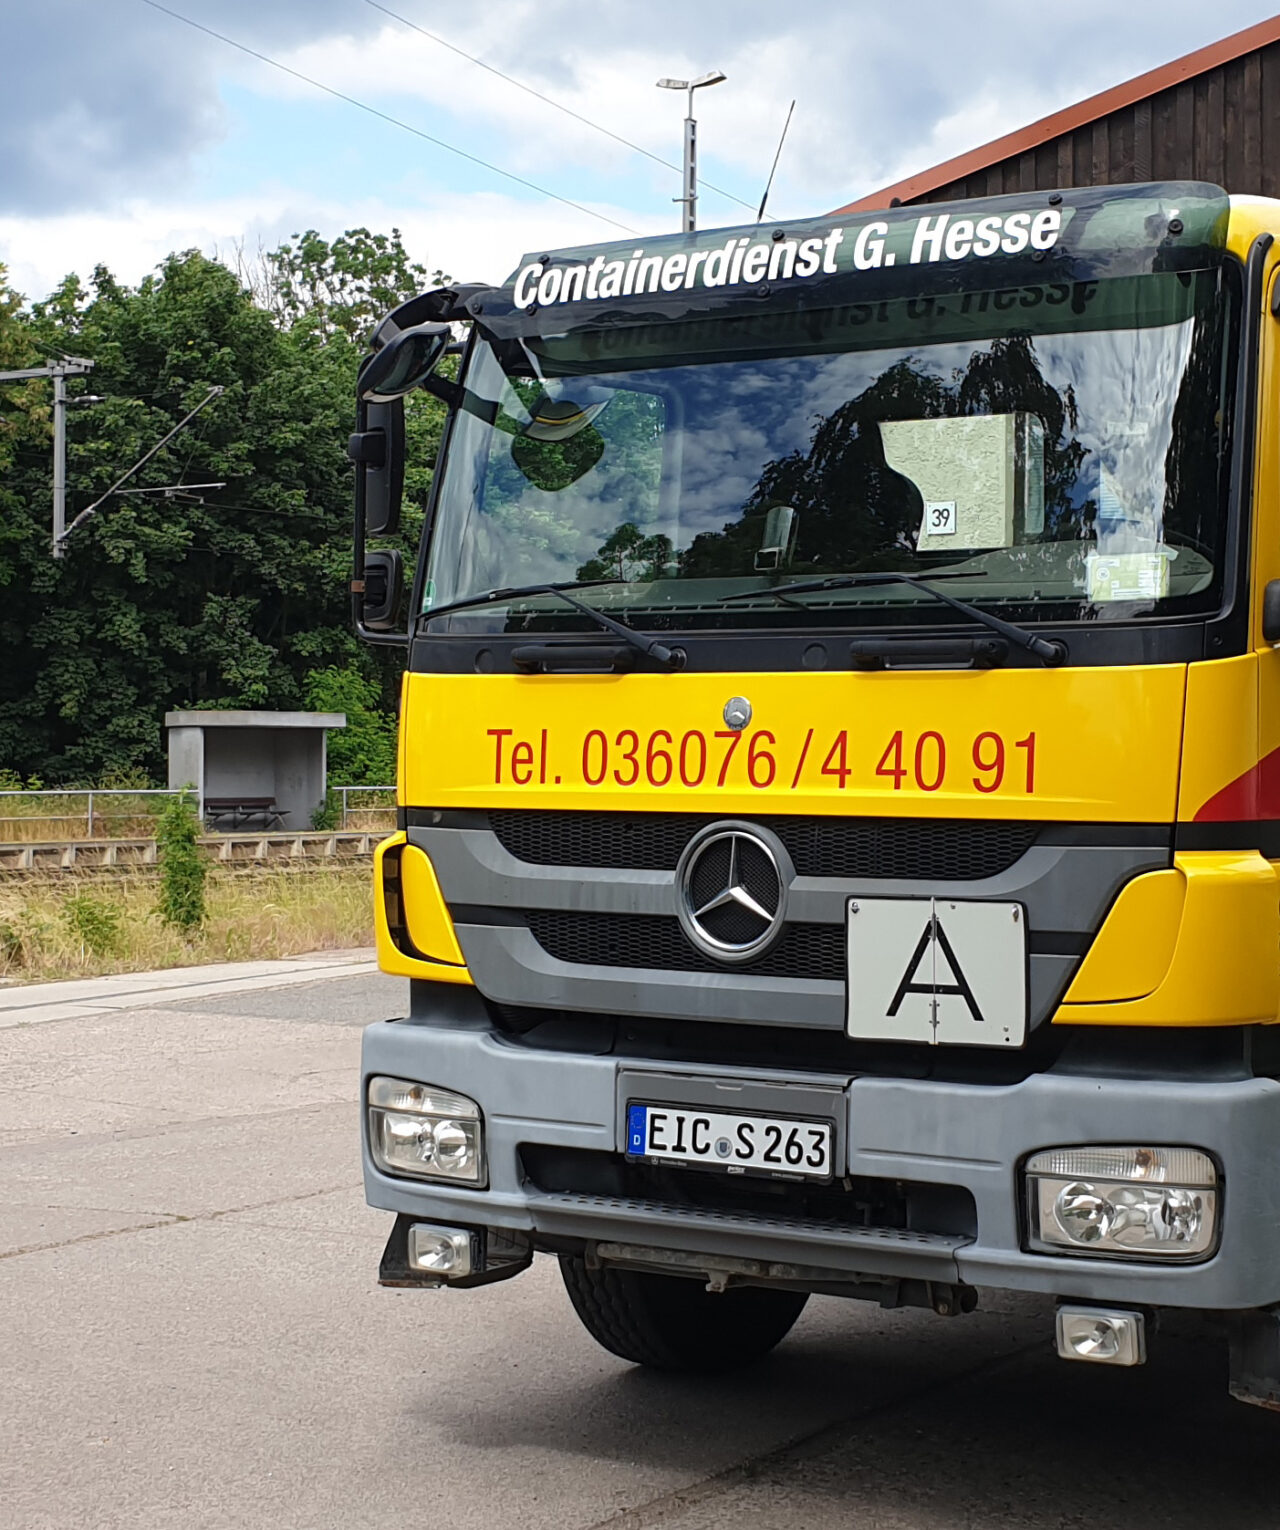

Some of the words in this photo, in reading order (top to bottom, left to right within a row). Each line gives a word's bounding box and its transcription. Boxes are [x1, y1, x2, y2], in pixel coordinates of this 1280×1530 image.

[513, 226, 844, 310] Containerdienst
[853, 221, 896, 273] G.
[909, 208, 1062, 264] Hesse
[931, 508, 951, 528] 39
[487, 728, 562, 785] Tel.
[875, 730, 946, 792] 40
[971, 731, 1037, 794] 91
[886, 920, 985, 1022] A
[633, 1134, 641, 1146] D
[649, 1113, 711, 1155] EIC
